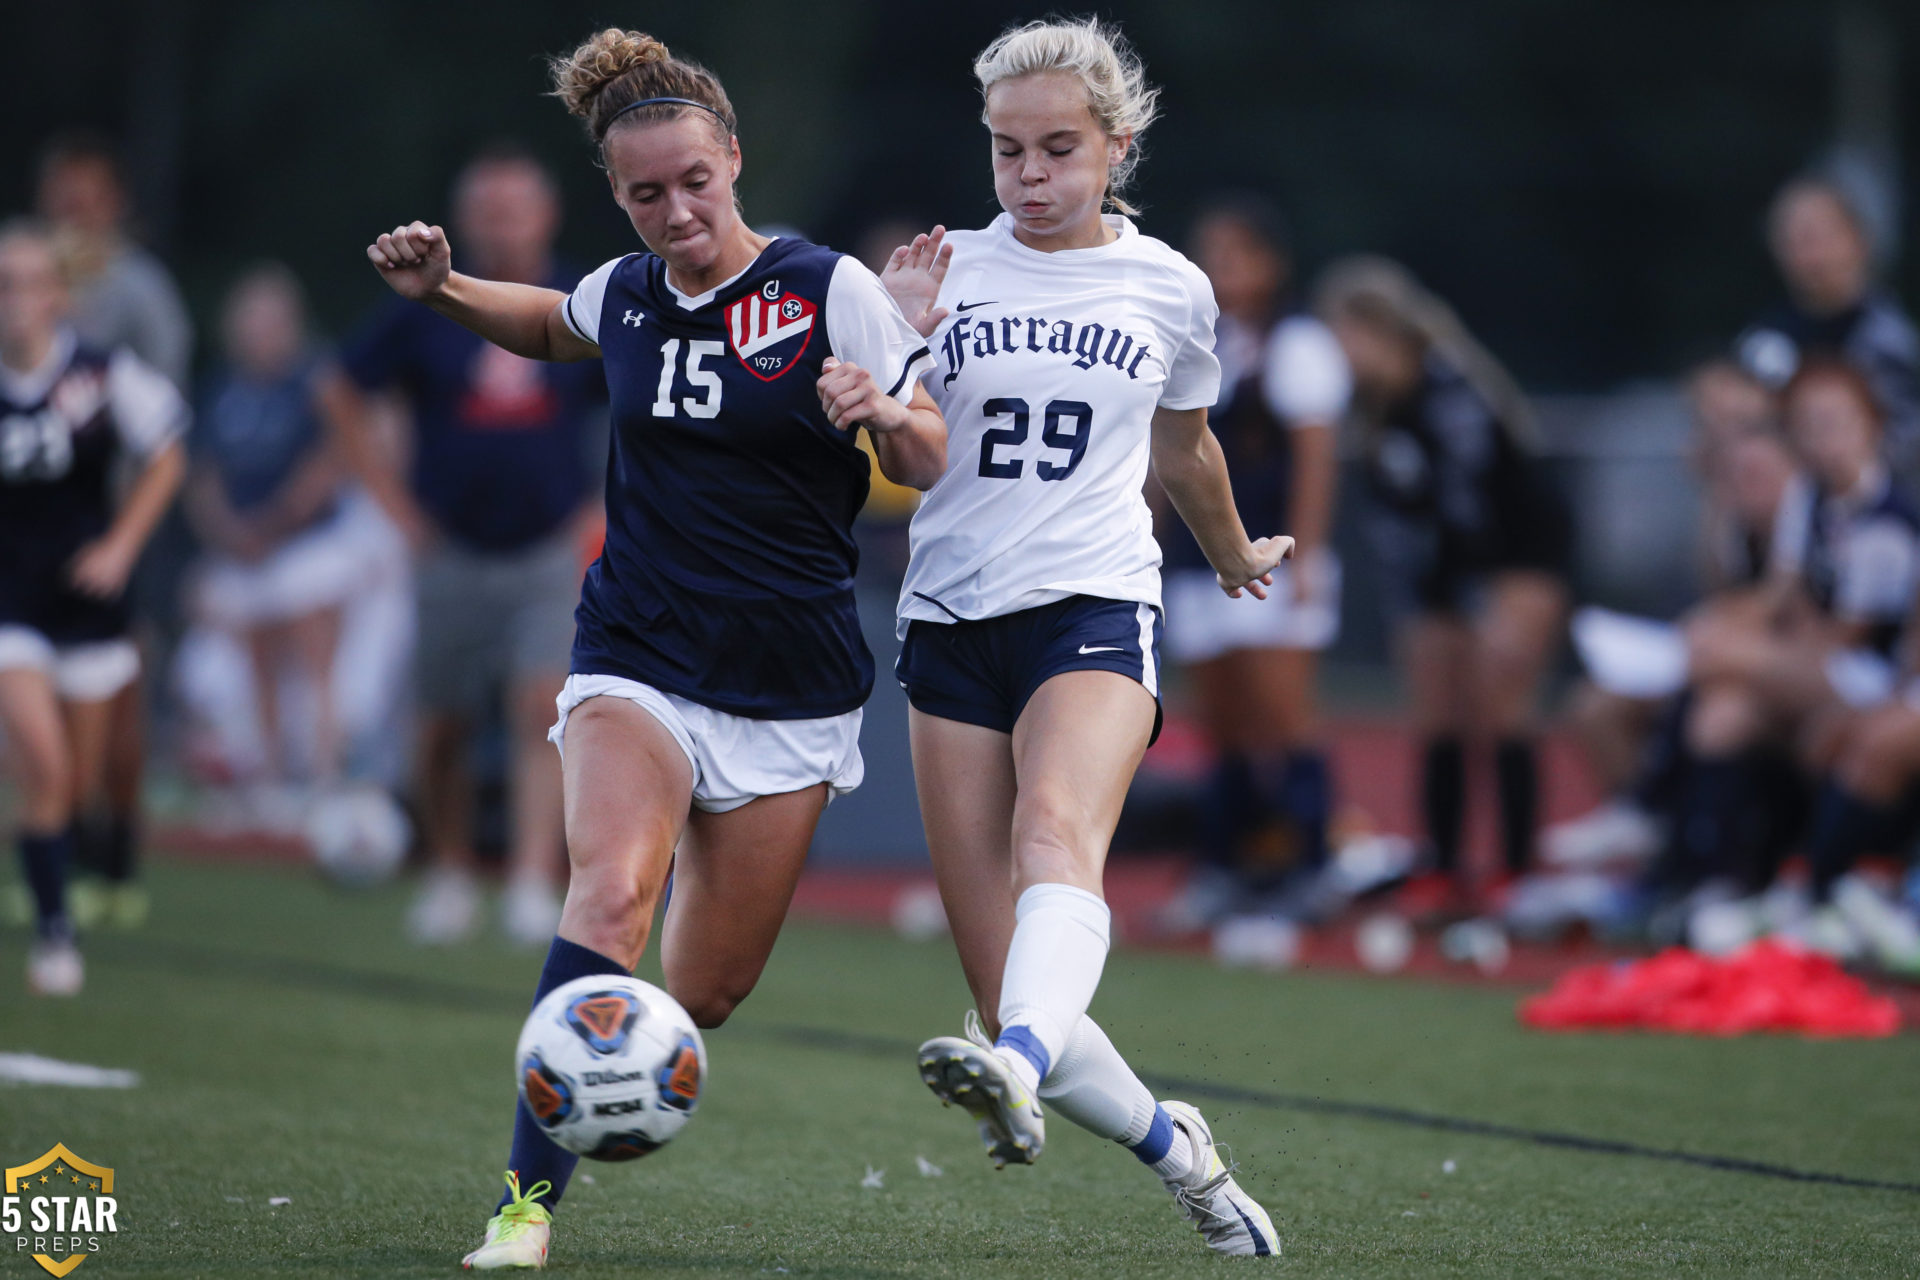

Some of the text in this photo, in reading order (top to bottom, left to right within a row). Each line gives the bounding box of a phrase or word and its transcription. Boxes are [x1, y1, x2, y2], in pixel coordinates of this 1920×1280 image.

[652, 338, 725, 419] 15
[754, 356, 783, 370] 1975
[941, 314, 1152, 391] Farragut
[978, 397, 1094, 482] 29
